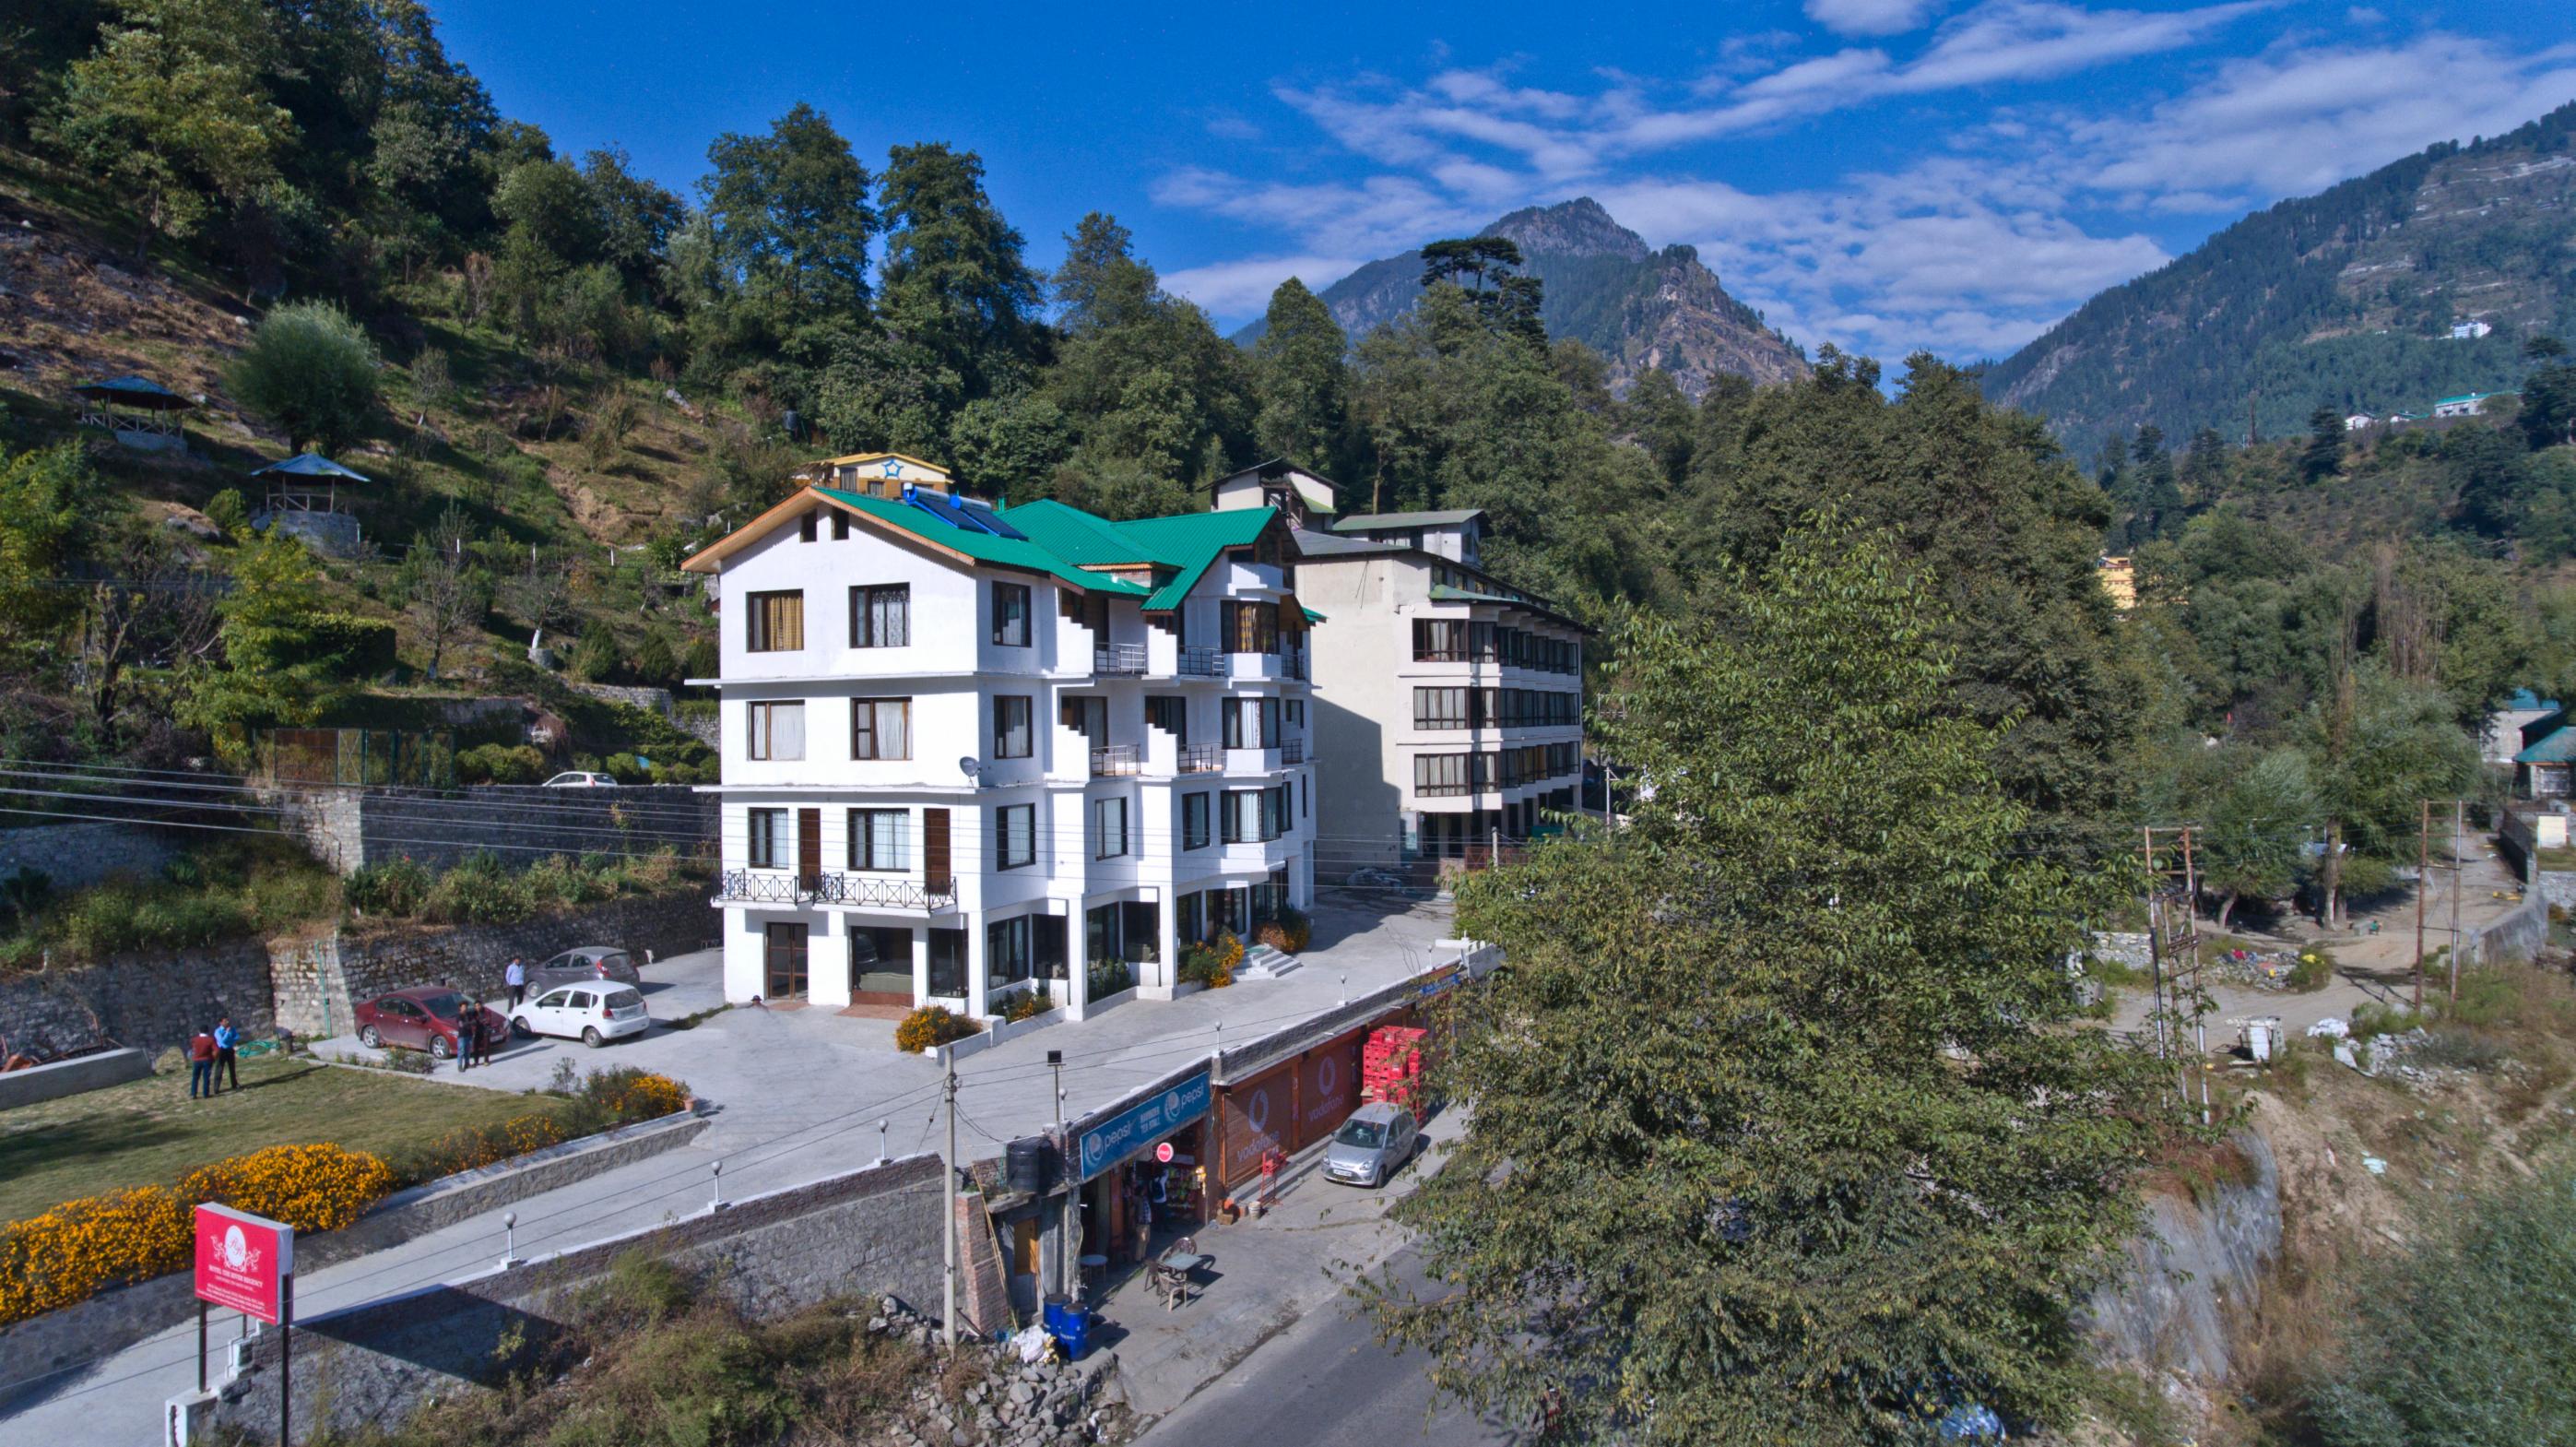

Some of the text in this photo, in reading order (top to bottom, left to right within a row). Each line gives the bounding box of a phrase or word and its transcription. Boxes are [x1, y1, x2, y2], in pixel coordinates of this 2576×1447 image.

[1181, 1083, 1204, 1109] pepsi
[1307, 1095, 1344, 1122] vodafone
[1105, 1121, 1131, 1151] pepsi
[1237, 1130, 1280, 1162] vodafone
